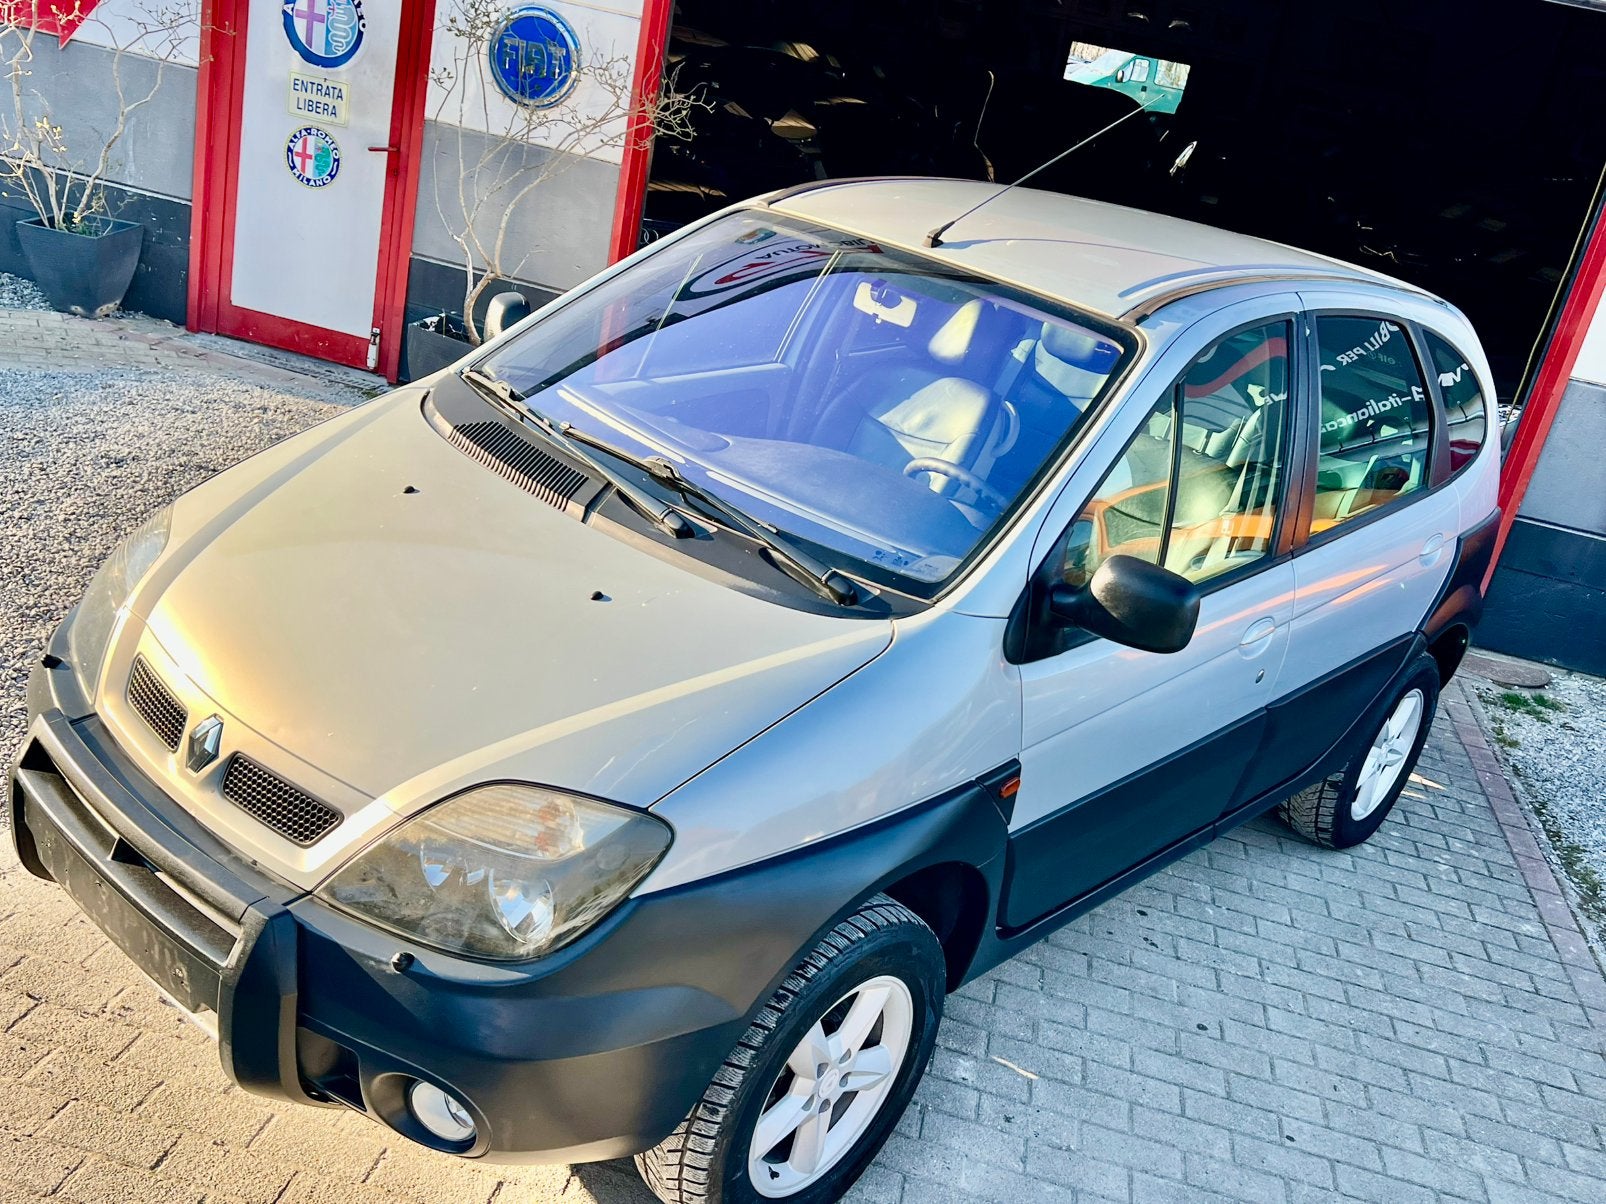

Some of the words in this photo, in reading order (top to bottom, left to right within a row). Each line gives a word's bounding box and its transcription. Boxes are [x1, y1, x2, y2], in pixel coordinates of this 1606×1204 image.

[502, 37, 566, 78] FIAT
[293, 78, 343, 101] ENTRATA
[296, 96, 337, 118] LIBERA
[291, 167, 332, 187] MILANO
